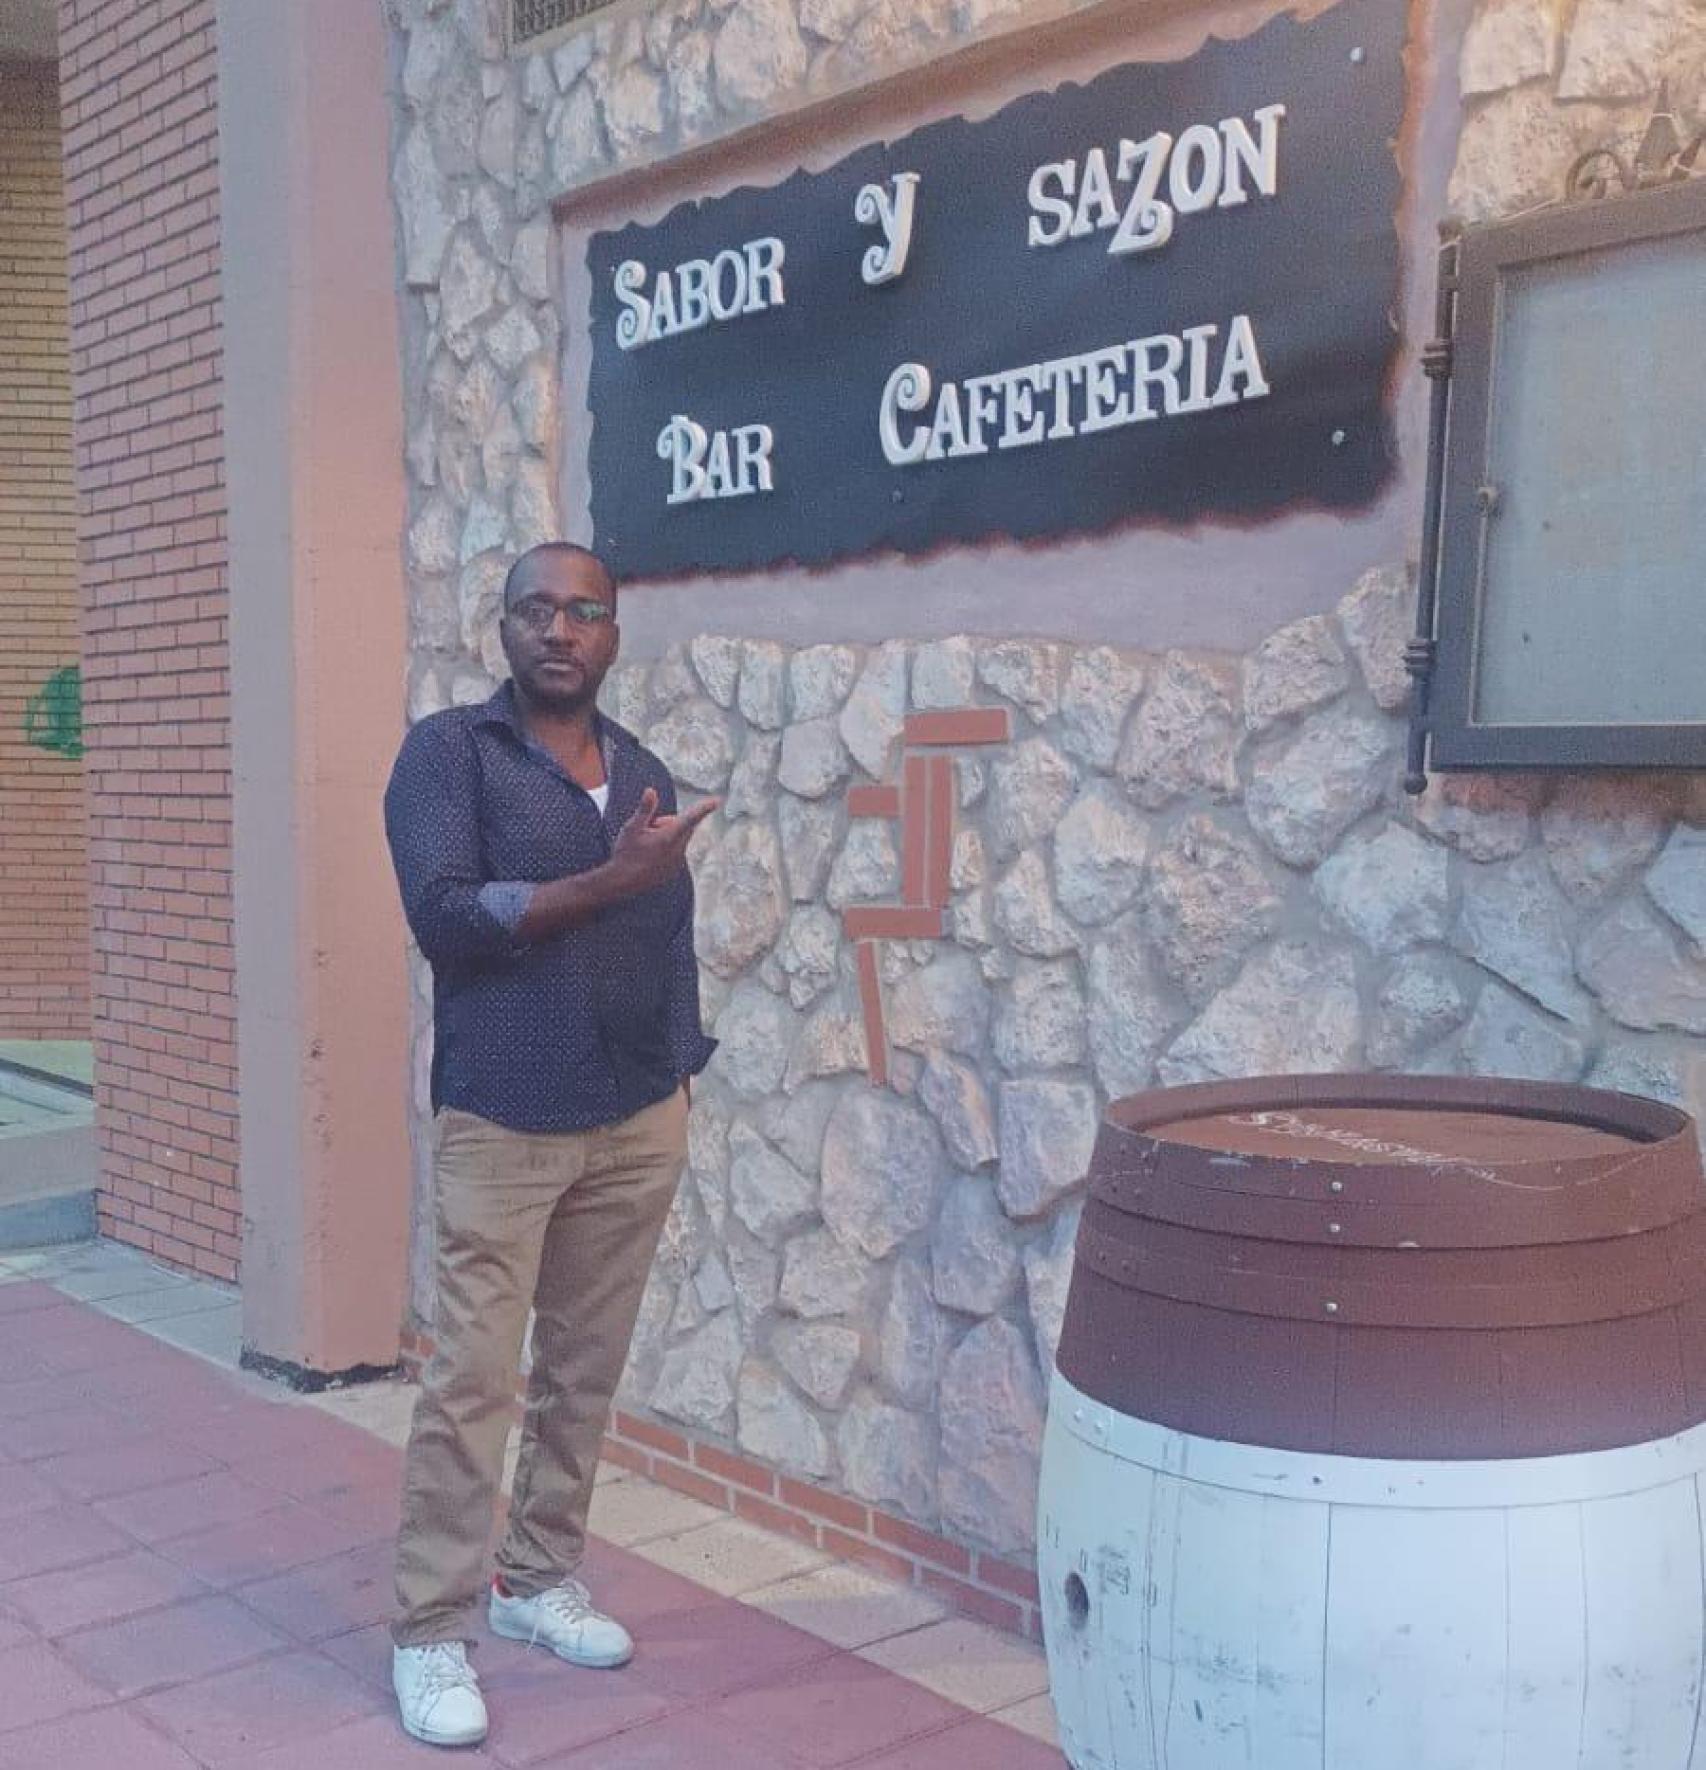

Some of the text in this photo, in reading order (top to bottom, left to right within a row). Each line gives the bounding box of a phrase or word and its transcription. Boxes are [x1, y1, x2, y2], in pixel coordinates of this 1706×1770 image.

[613, 236, 786, 350] SABOR
[1028, 104, 1287, 255] SAZON
[657, 315, 1270, 505] BAR CAFETERIA
